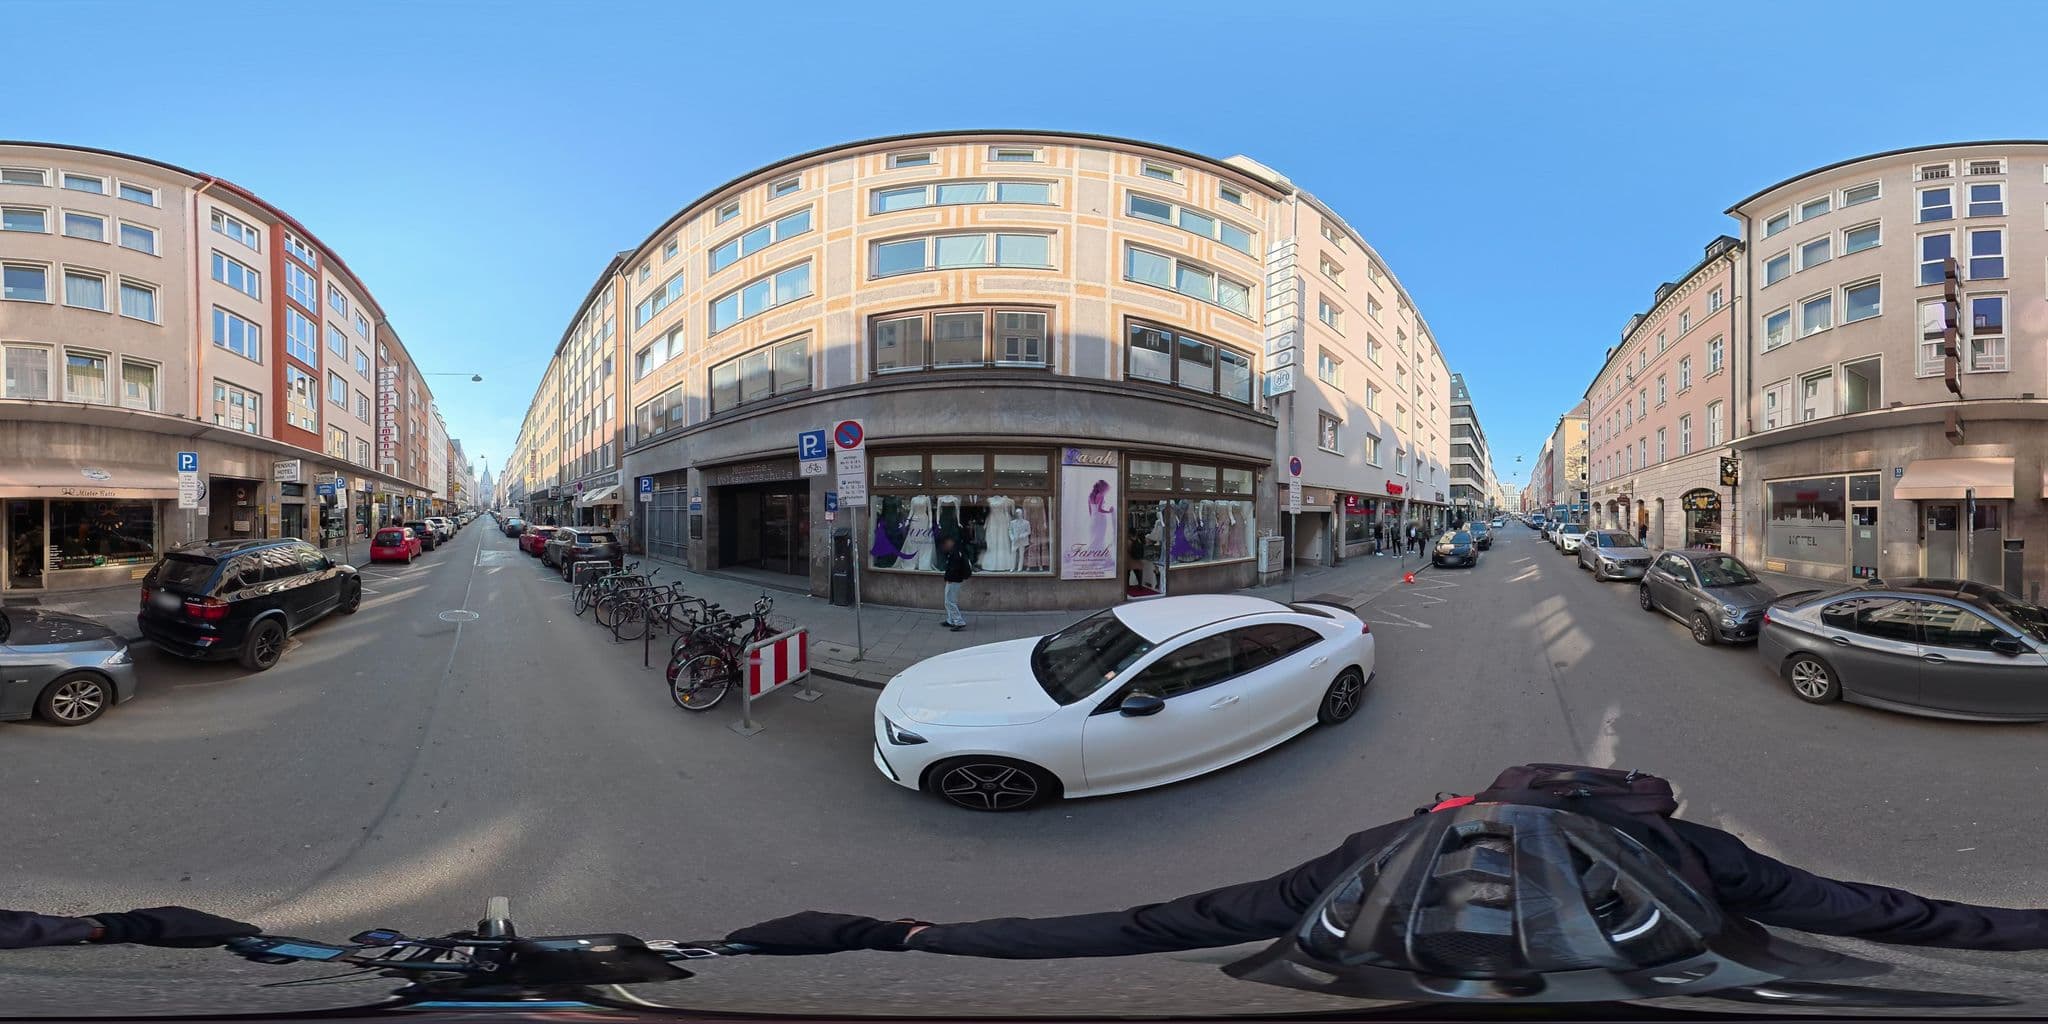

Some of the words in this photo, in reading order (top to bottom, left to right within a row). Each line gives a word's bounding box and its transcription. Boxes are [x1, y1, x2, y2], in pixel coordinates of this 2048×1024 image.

[803, 435, 818, 457] P
[183, 454, 193, 470] P
[642, 480, 649, 491] P
[1067, 543, 1112, 559] Farah
